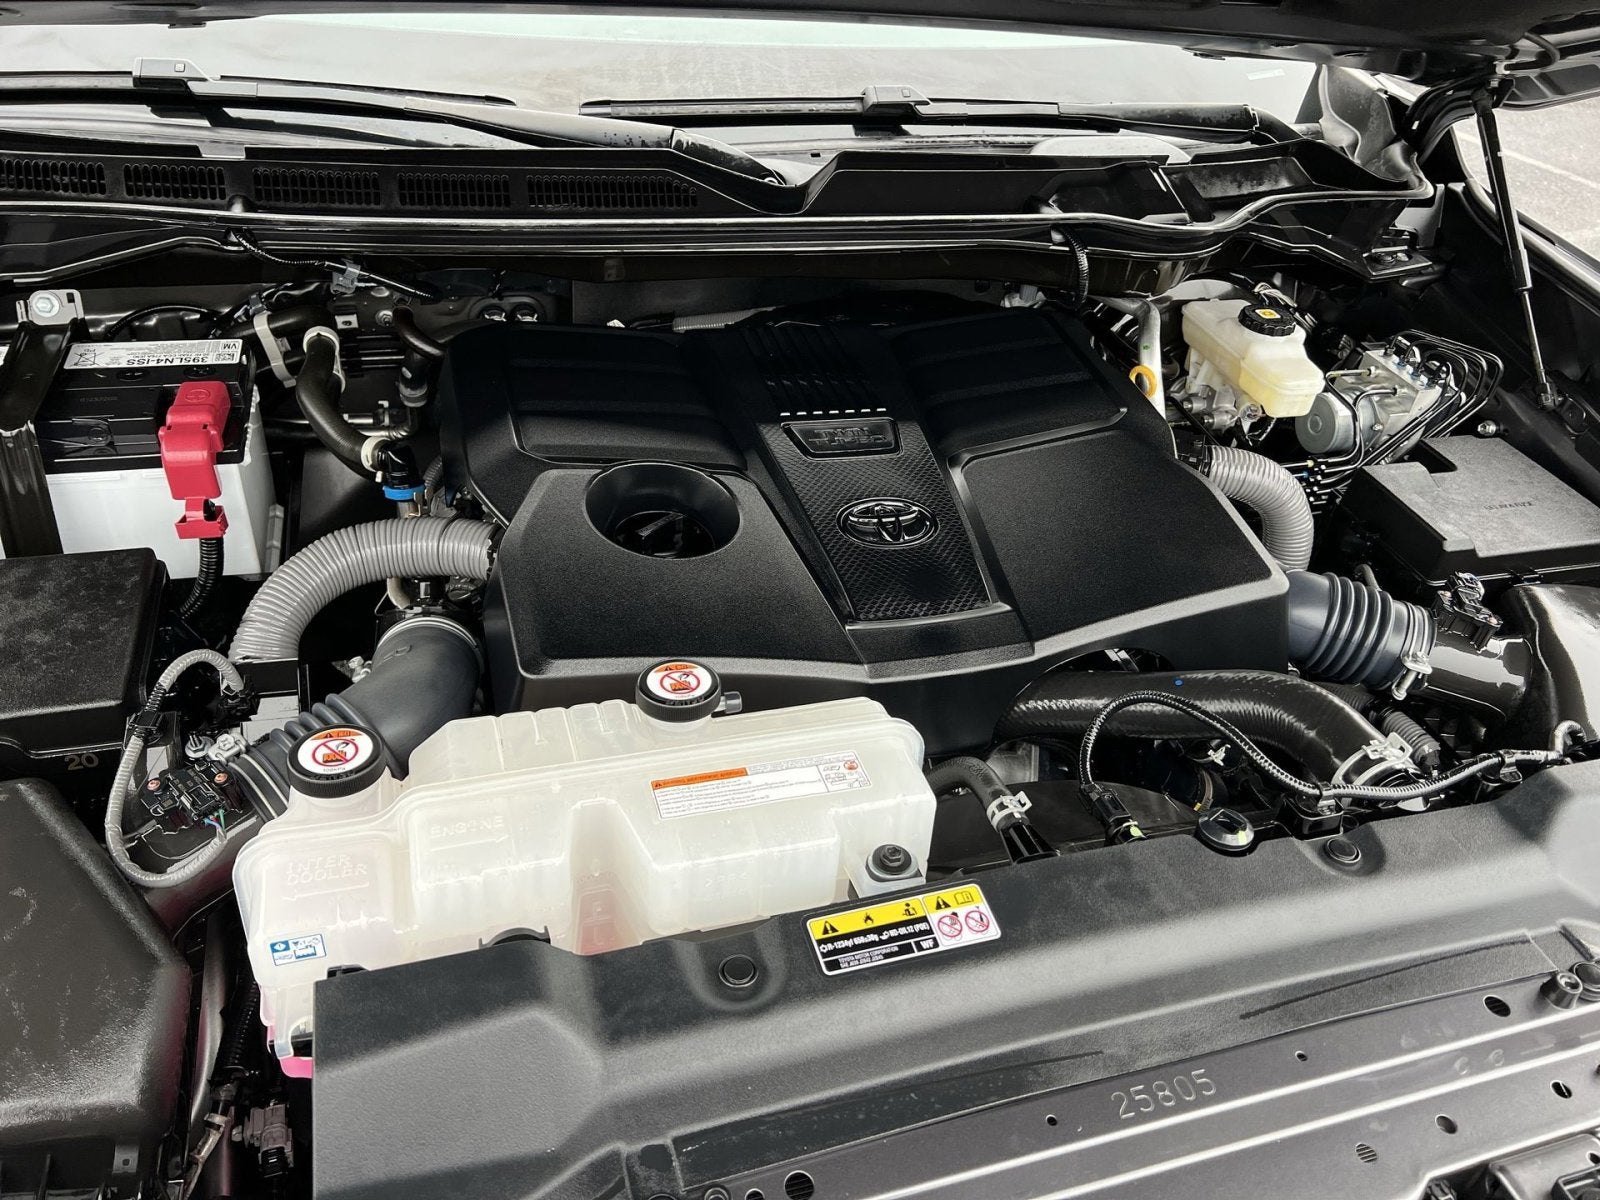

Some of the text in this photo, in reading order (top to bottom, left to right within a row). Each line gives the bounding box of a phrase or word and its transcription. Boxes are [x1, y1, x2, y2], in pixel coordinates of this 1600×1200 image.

[126, 356, 209, 365] 395LN4-ISS
[814, 427, 870, 438] TWIN
[808, 434, 888, 446] TURBO
[64, 753, 99, 770] 20
[429, 816, 505, 839] ENGINE
[286, 854, 351, 875] INTER
[920, 939, 935, 949] WF
[1110, 1069, 1217, 1119] 25805
